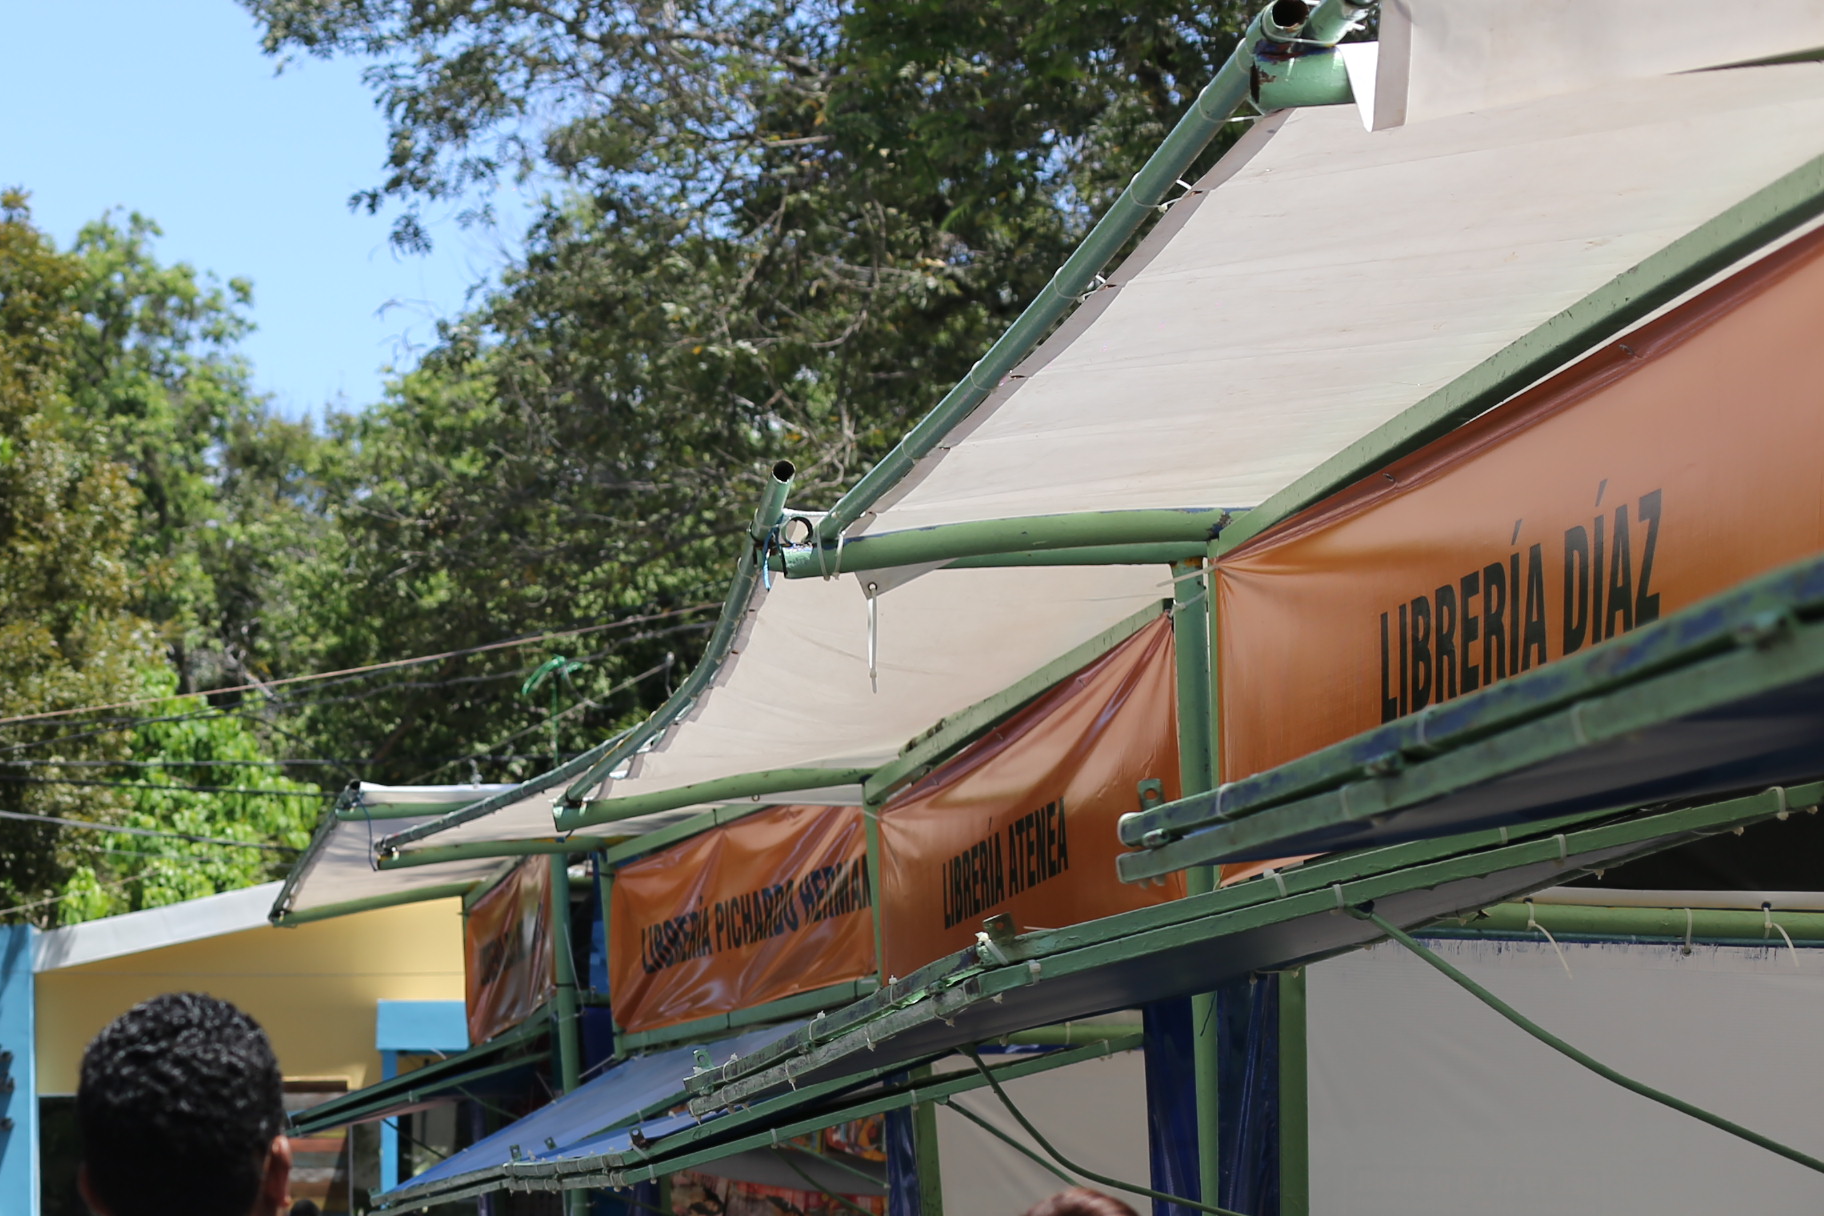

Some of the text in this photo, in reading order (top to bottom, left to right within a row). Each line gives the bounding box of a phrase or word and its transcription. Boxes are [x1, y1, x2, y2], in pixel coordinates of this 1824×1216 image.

[1379, 478, 1662, 725] LIBRERÍA DÍAZ
[714, 878, 799, 952] PICHARDO
[942, 796, 1069, 930] LIBRERÍA ATENEA
